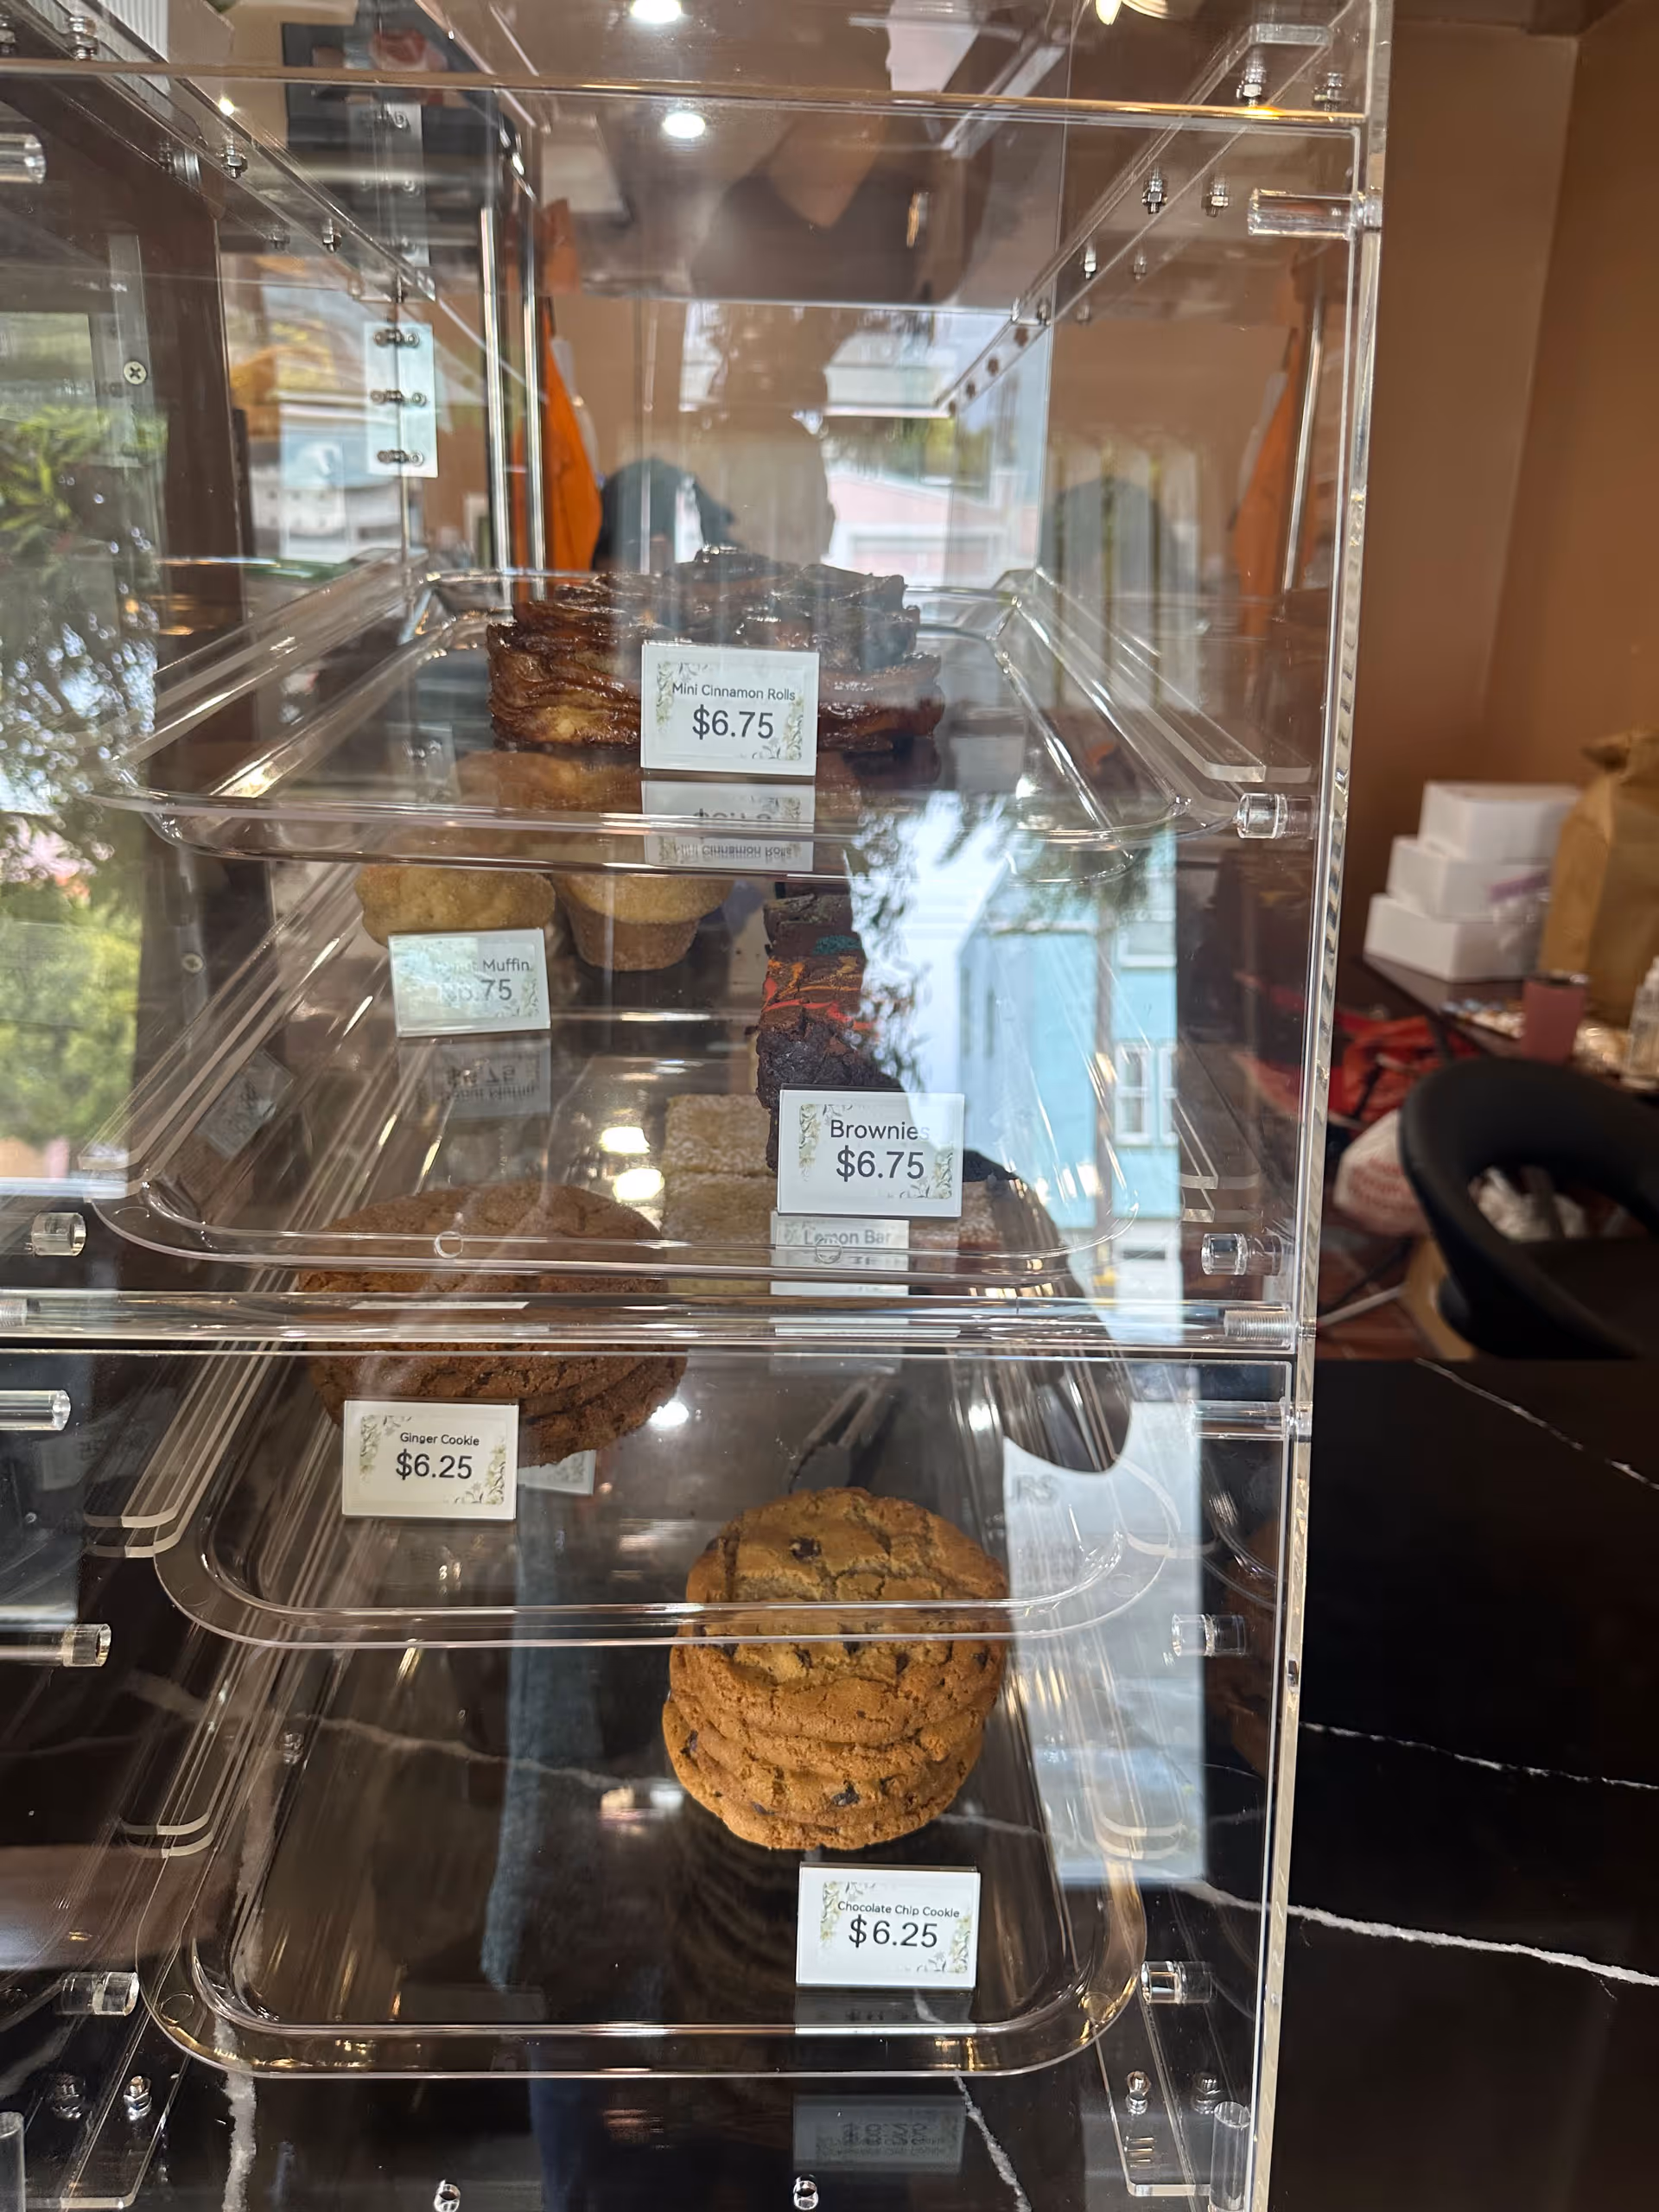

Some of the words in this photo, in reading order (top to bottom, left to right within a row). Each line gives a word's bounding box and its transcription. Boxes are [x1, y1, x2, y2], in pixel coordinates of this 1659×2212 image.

[672, 682, 698, 696] Mini
[701, 683, 765, 701] Cinnamon
[767, 688, 796, 702] Rolls
[692, 703, 774, 741] $6.75
[482, 957, 531, 973] Muffin
[830, 1119, 931, 1141] Brownies
[836, 1144, 925, 1183] $6.75
[804, 1230, 860, 1246] Lemon
[865, 1230, 892, 1246] Bar
[399, 1432, 439, 1446] Ginger
[441, 1433, 480, 1446] Cookie
[395, 1448, 474, 1481] $6.25
[837, 1900, 893, 1915] Chocolate
[894, 1904, 920, 1917] Chip
[922, 1906, 961, 1918] Cookie
[848, 1913, 939, 1949] $6.25
